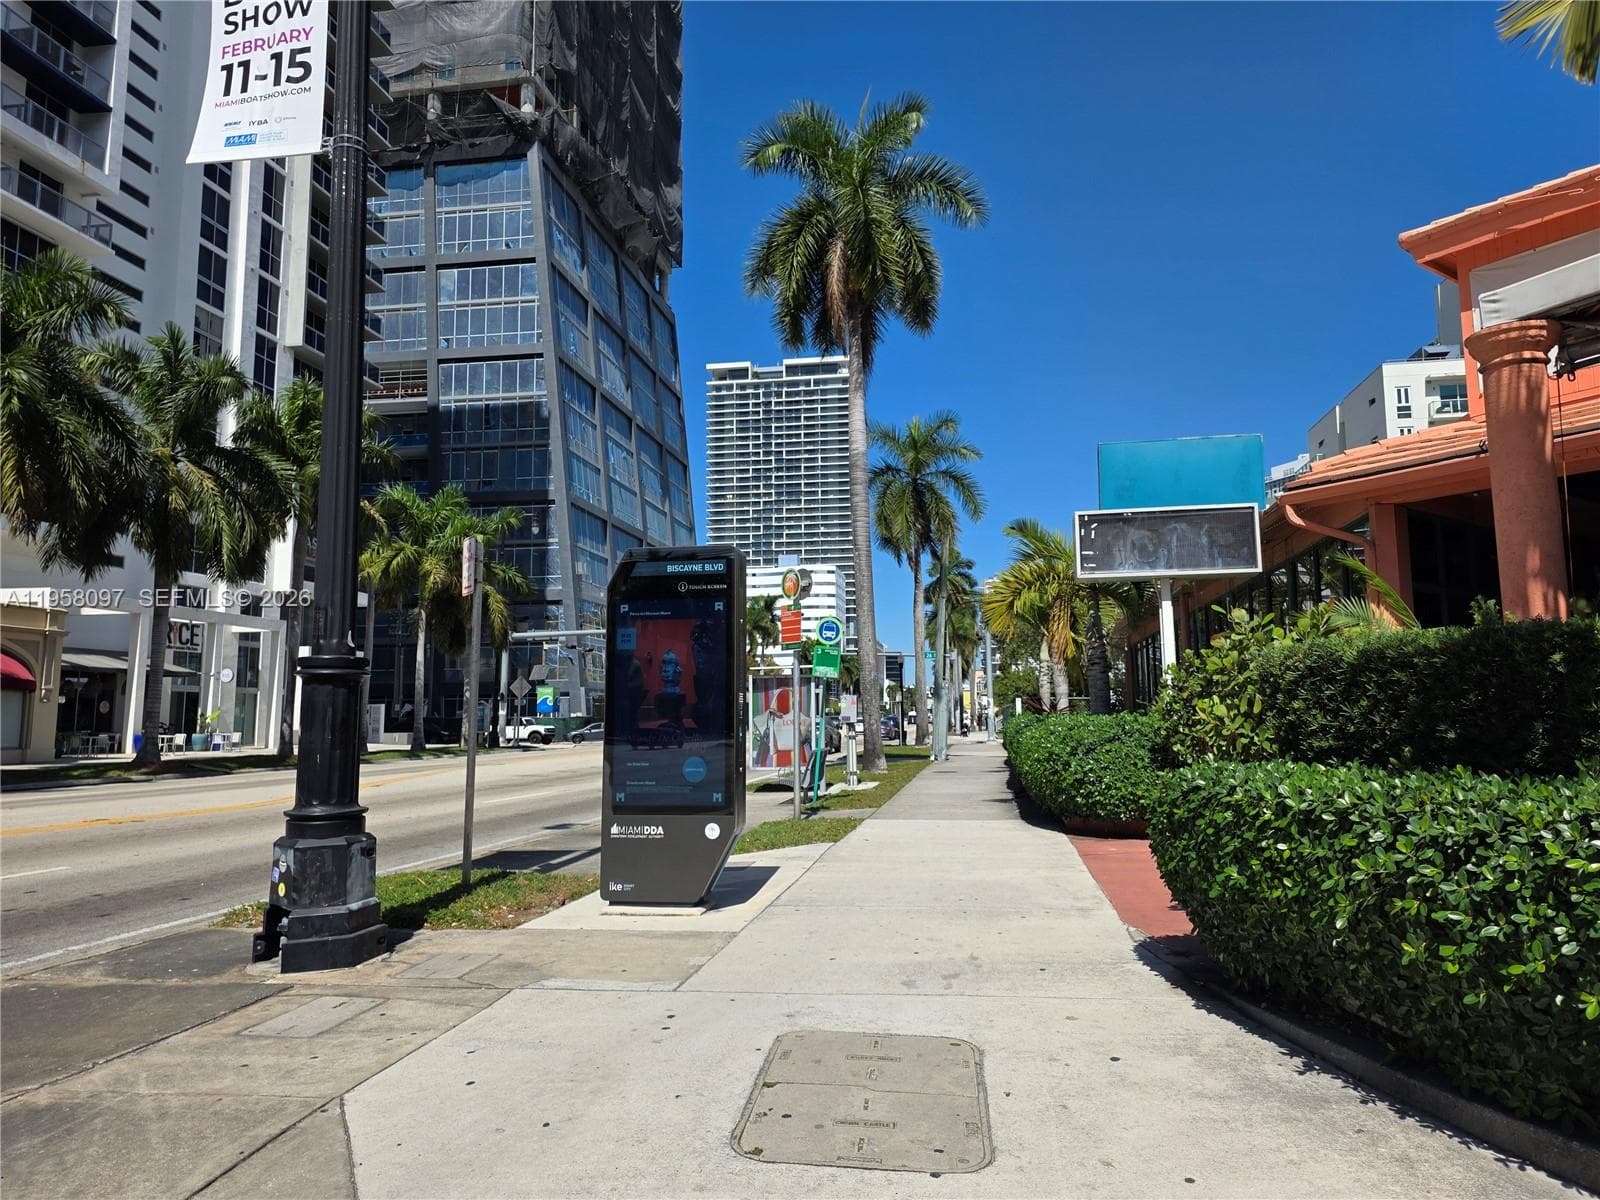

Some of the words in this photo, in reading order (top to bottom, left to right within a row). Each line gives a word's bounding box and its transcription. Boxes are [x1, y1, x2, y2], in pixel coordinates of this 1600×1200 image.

[224, 0, 313, 35] SHOW
[222, 26, 314, 60] FEBRUARY
[220, 46, 313, 97] 11-15
[214, 86, 312, 109] MIAMIBOATSHOW.COM
[666, 563, 703, 573] BISCAYNE
[704, 563, 724, 571] BLVD
[609, 881, 623, 891] ike
